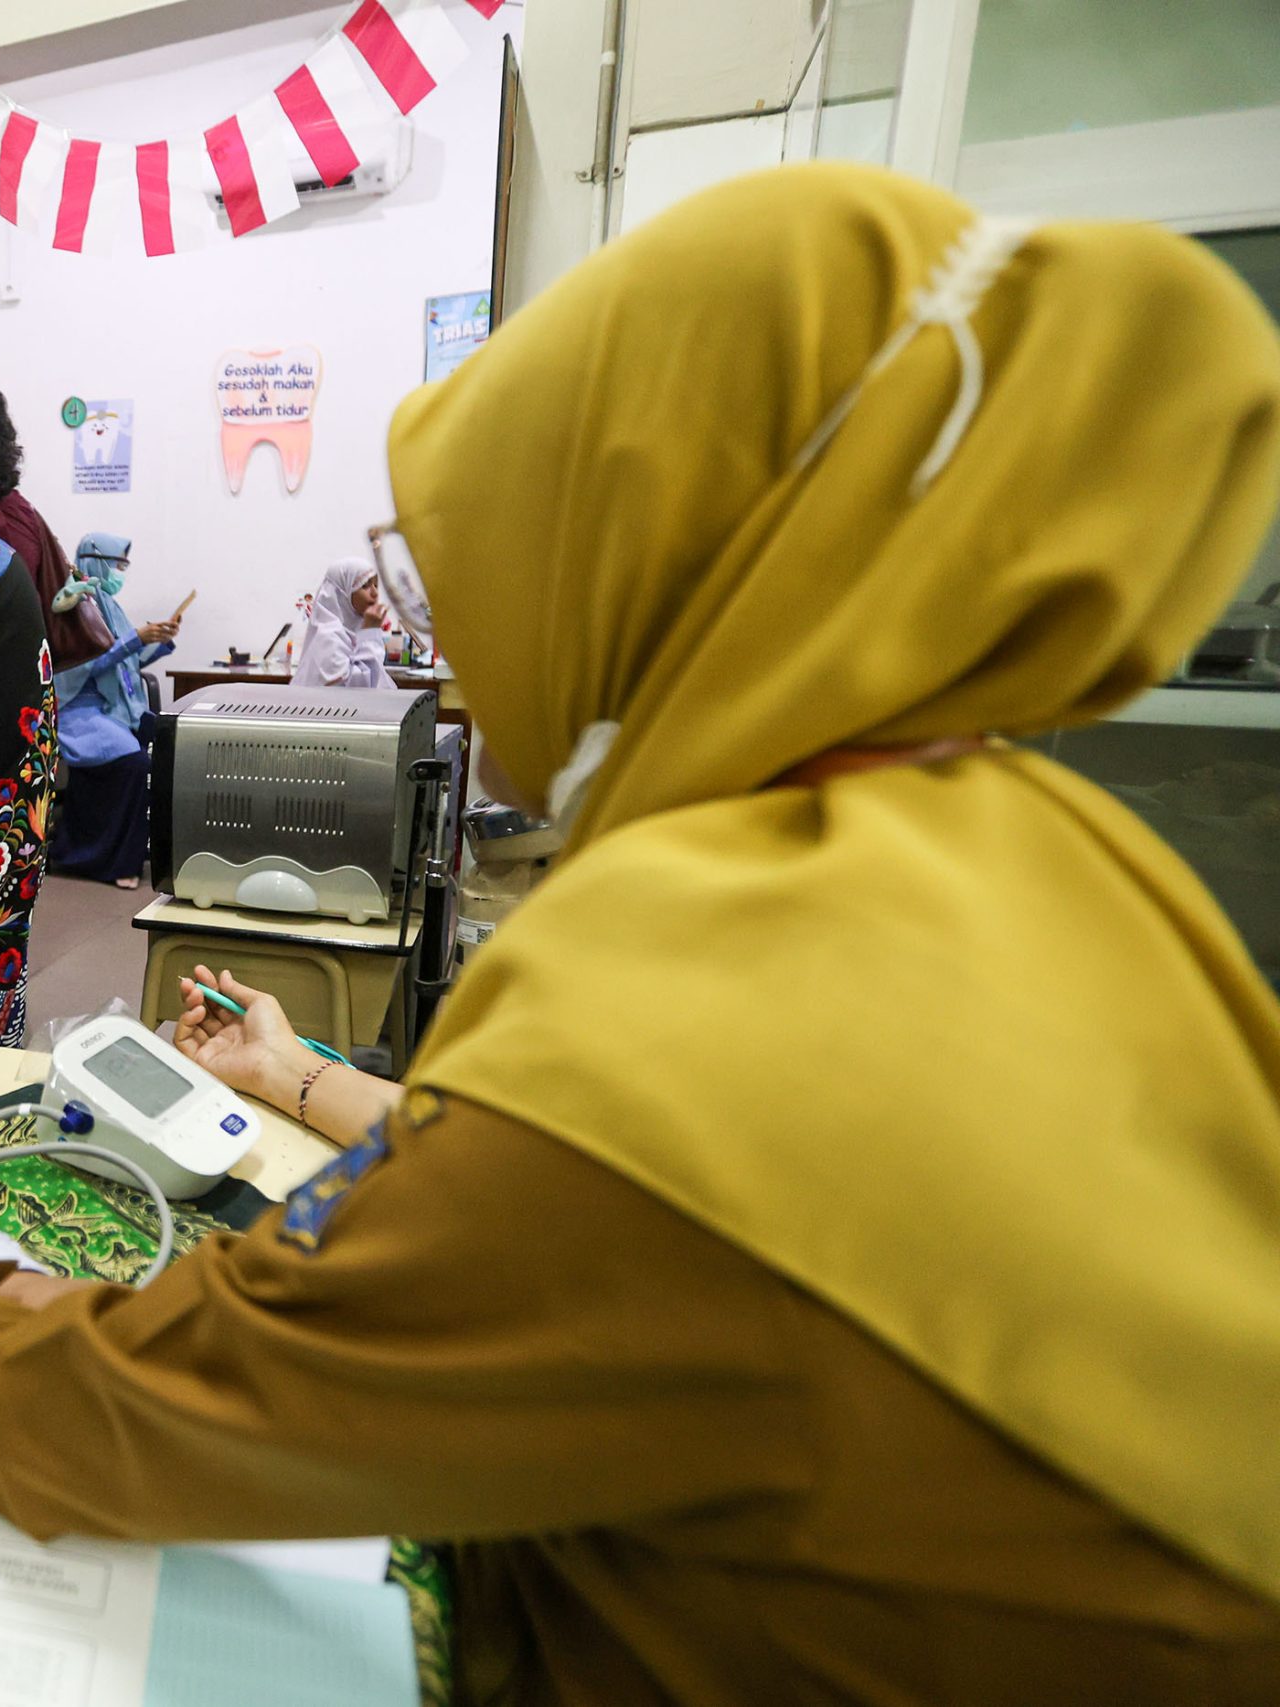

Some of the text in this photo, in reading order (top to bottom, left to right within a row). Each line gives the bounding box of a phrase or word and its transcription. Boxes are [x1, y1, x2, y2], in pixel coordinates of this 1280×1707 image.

[224, 362, 313, 377] Gosoklah Aku
[218, 378, 315, 391] sesudah makan
[258, 390, 269, 403] &
[69, 402, 78, 421] 4
[223, 402, 309, 417] sebelum tidur
